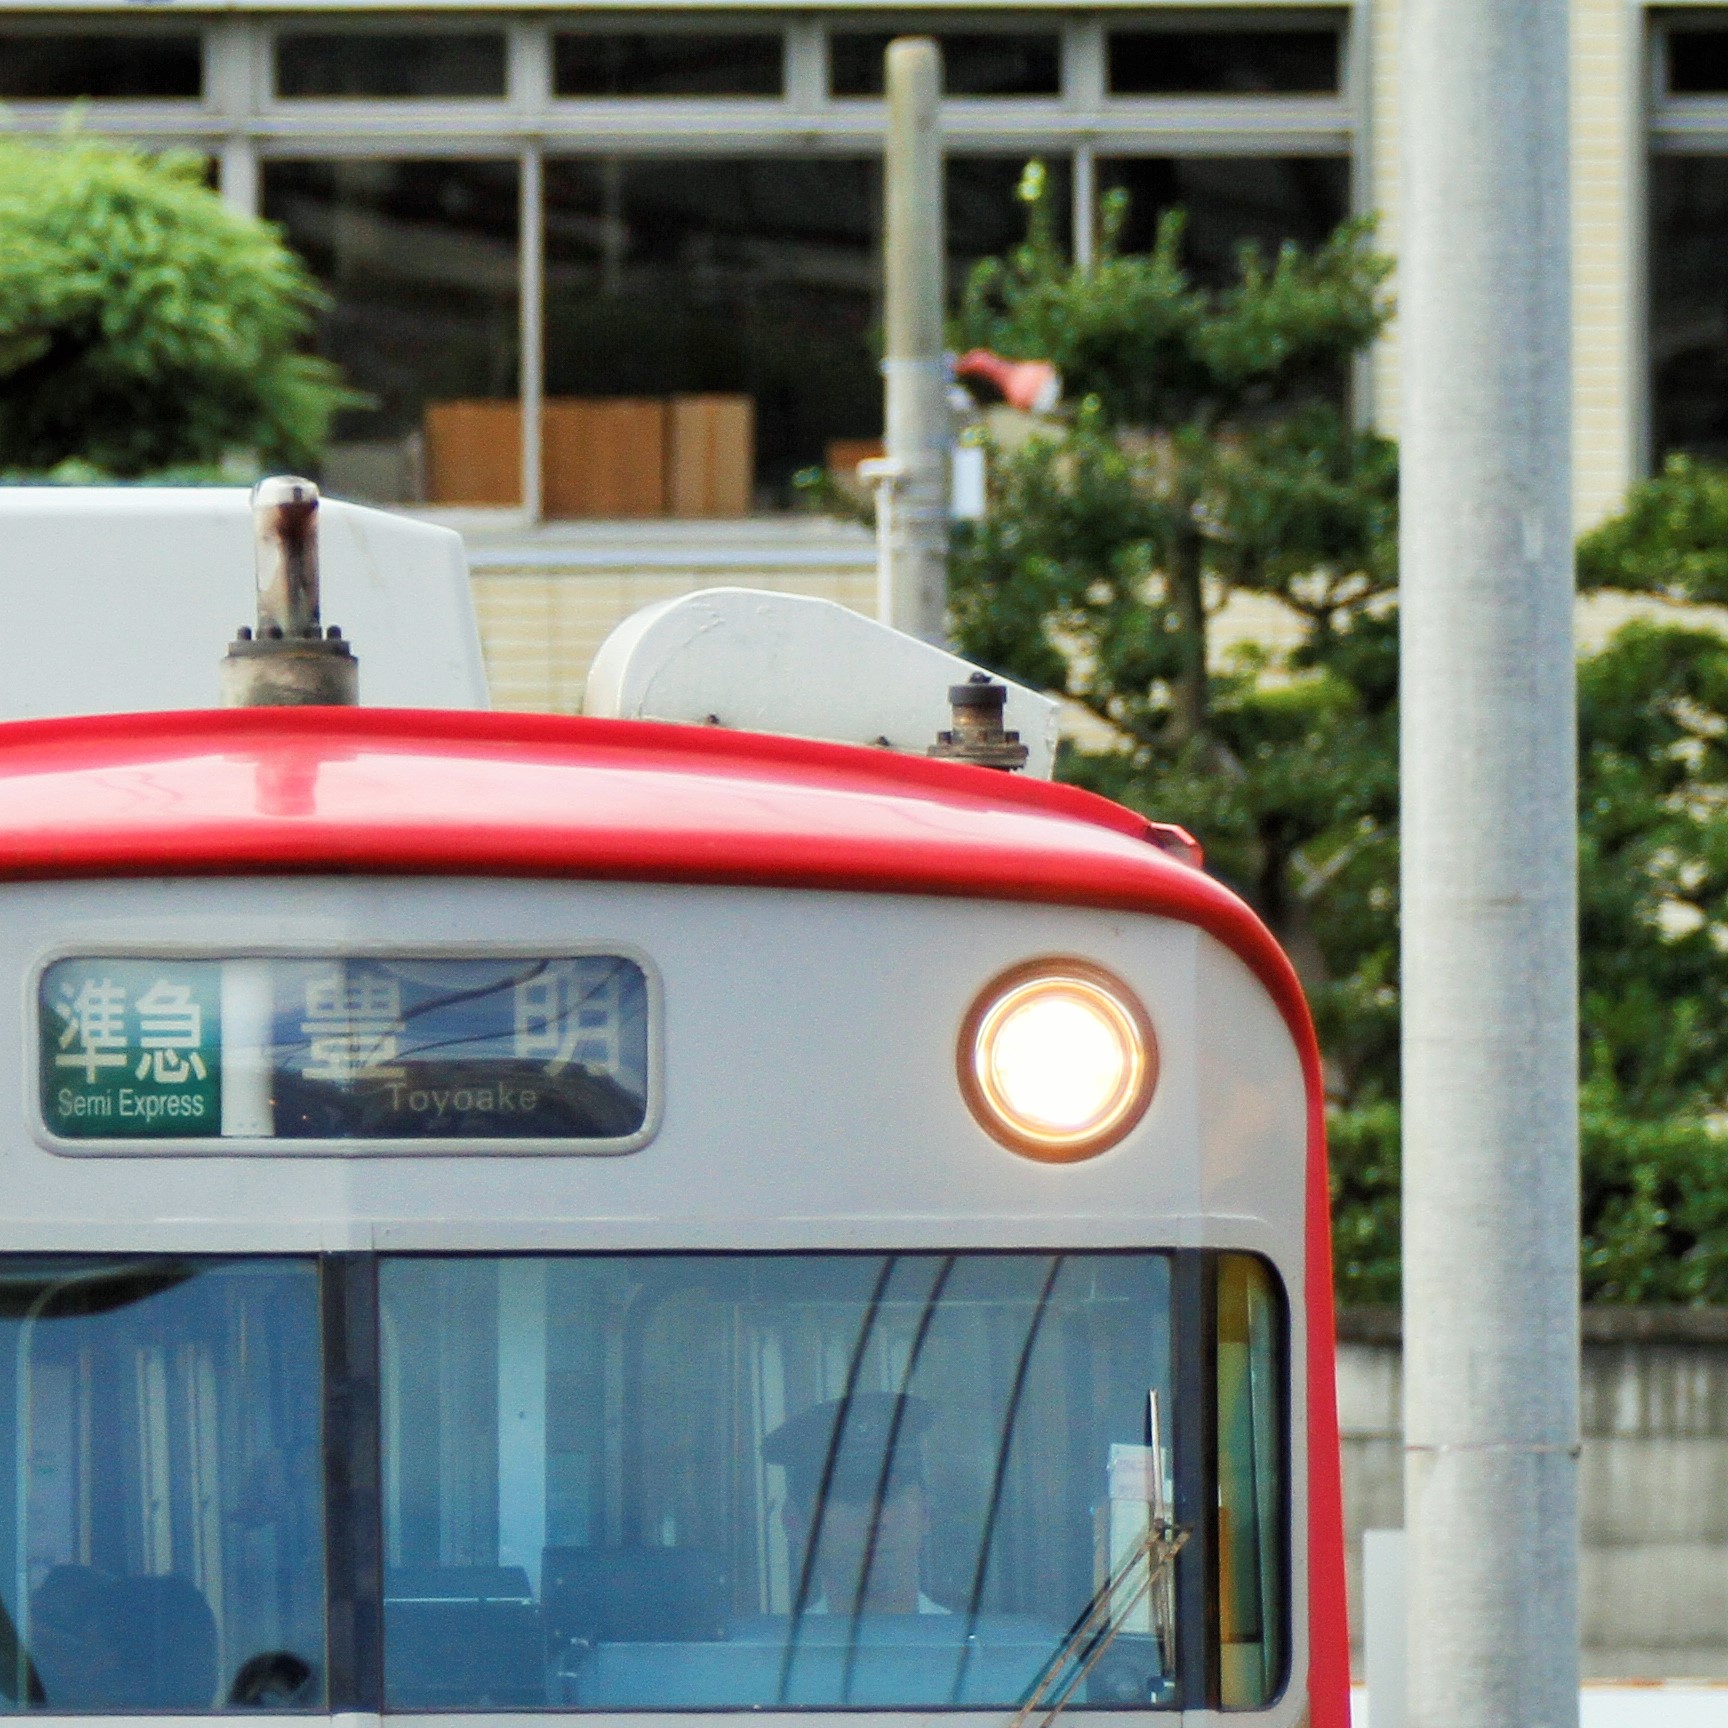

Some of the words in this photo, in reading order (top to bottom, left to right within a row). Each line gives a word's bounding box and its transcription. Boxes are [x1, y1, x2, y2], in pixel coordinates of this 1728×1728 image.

[53, 977, 208, 1084] 準急
[300, 967, 621, 1081] 豊明
[57, 1088, 112, 1117] Semi
[118, 1088, 206, 1122] Express
[386, 1082, 539, 1117] Toyoake
